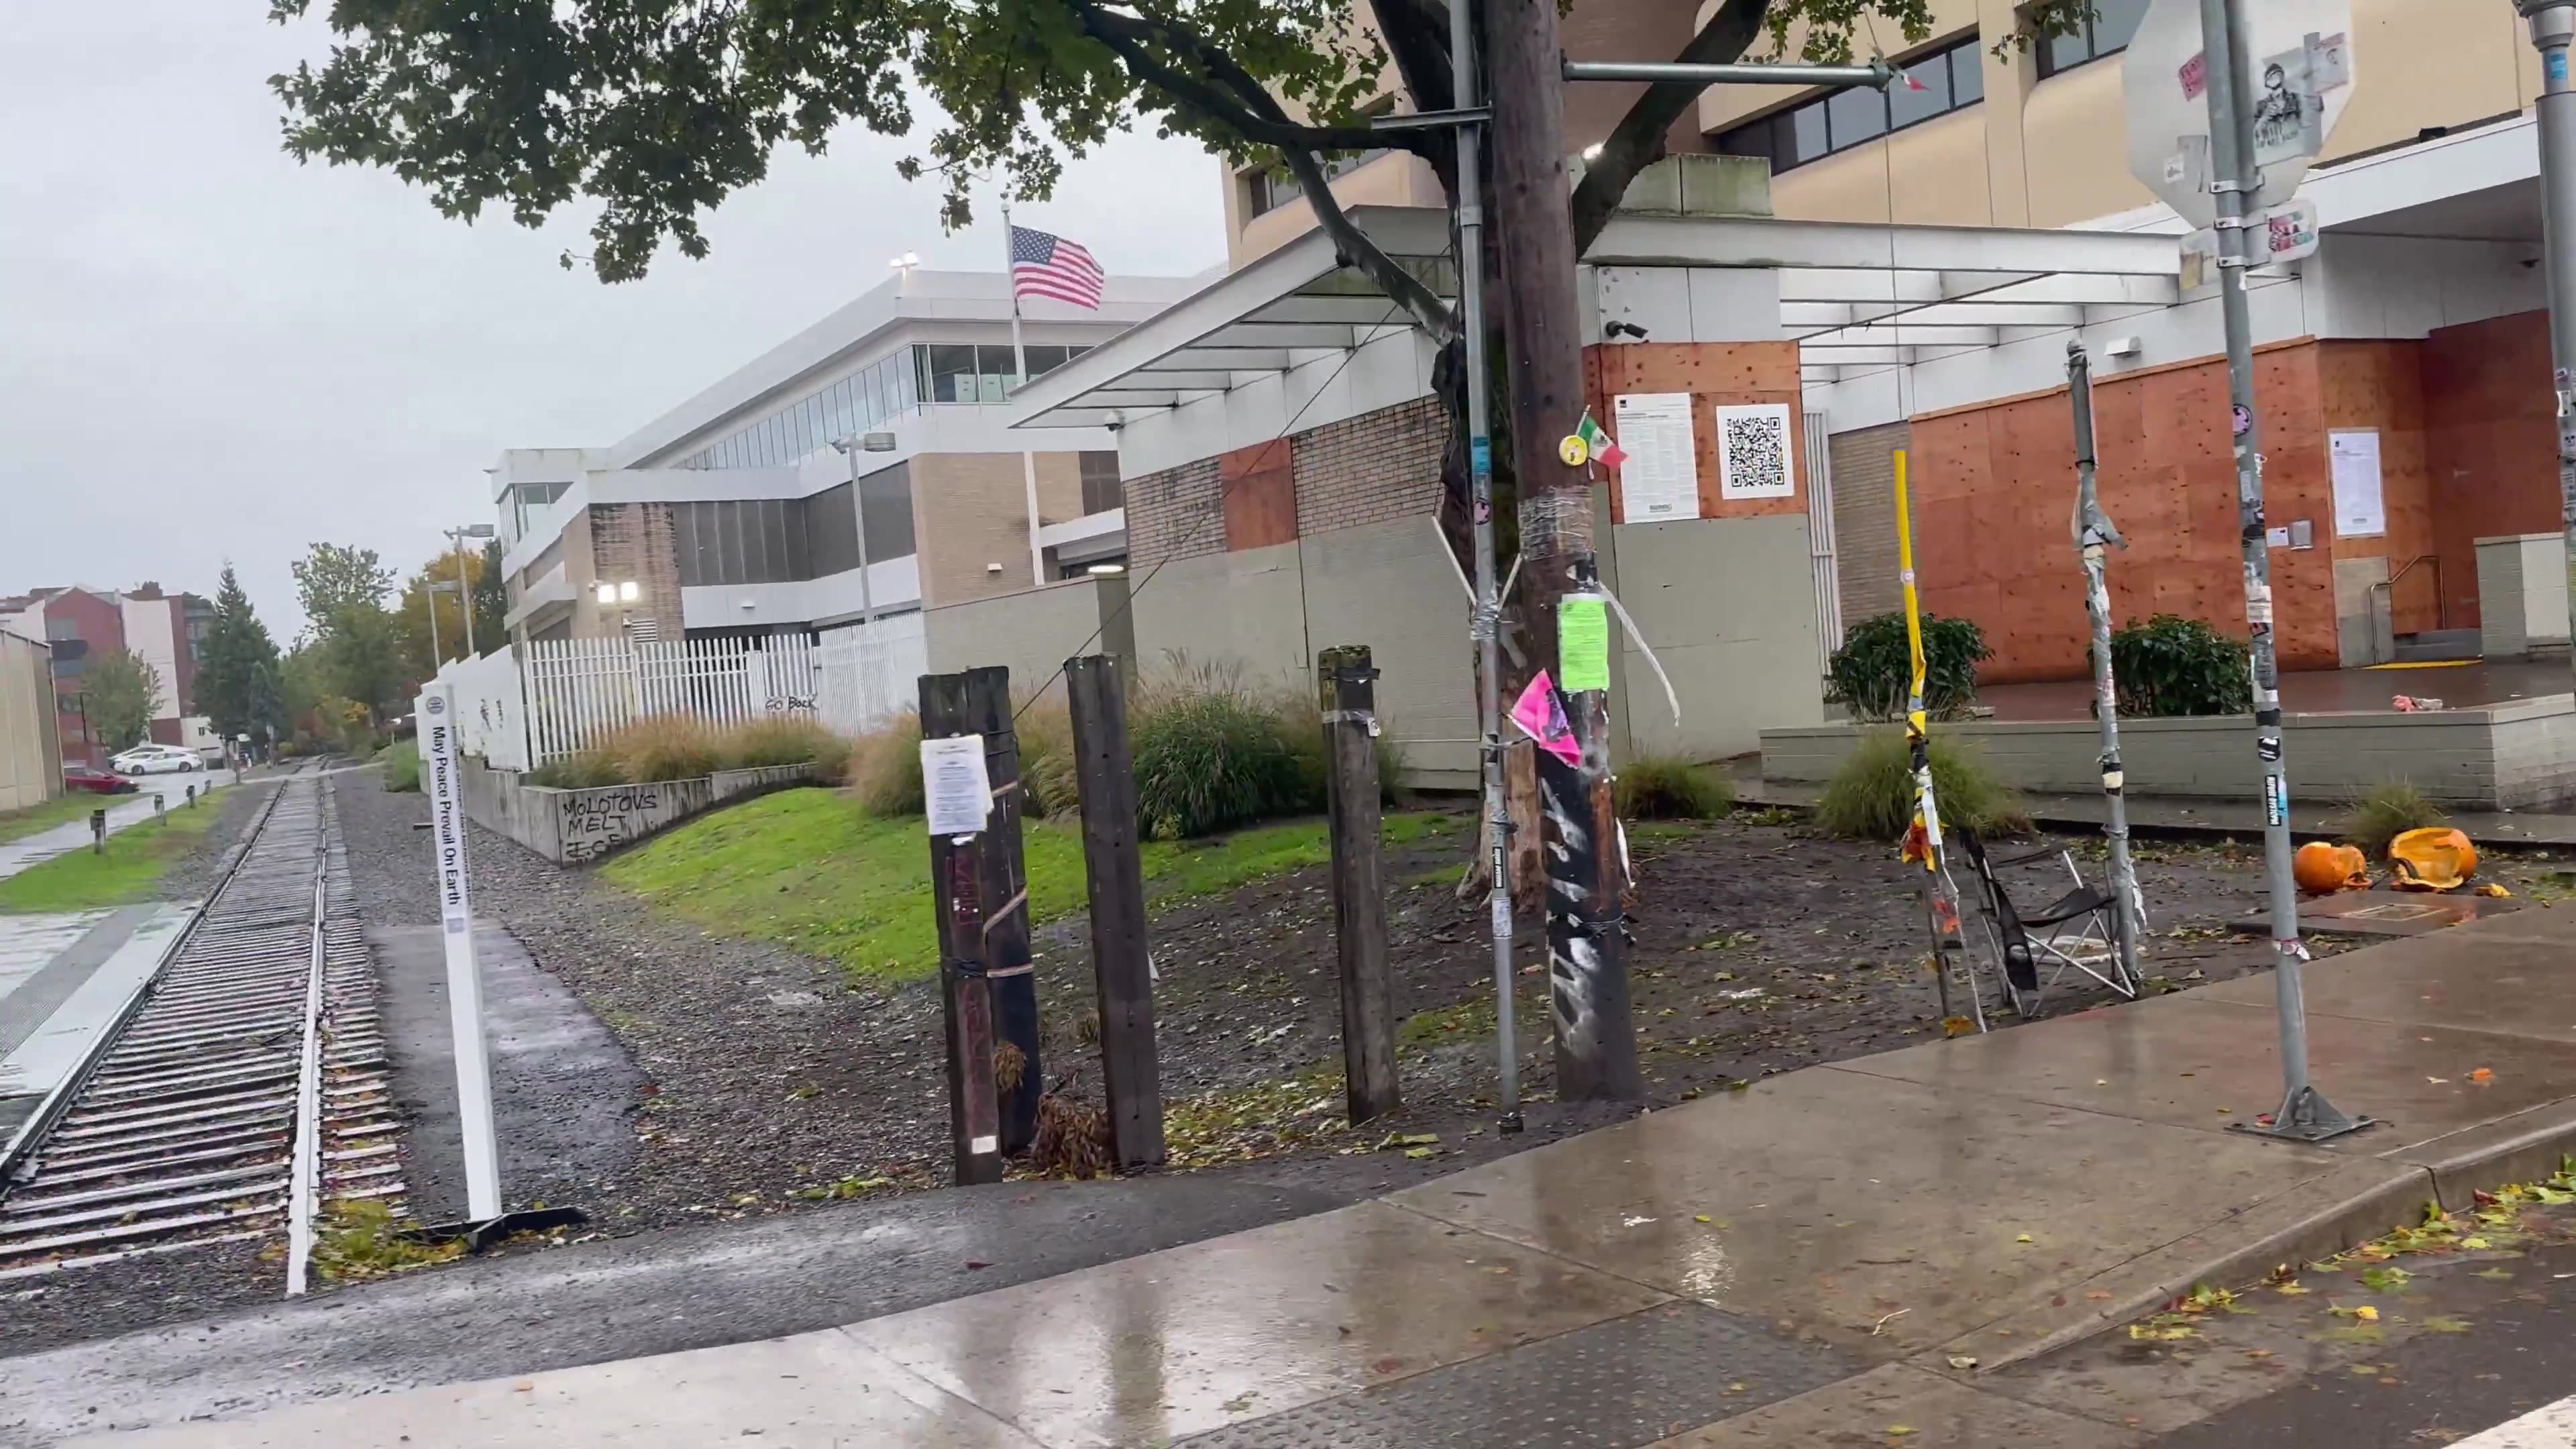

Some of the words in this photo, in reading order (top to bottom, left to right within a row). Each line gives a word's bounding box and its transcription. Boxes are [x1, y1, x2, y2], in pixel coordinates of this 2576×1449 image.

[765, 699, 783, 710] GO
[433, 727, 445, 760] May
[436, 757, 449, 798] Peace
[564, 794, 657, 816] MOLOTOVS
[440, 801, 455, 844] Prevail
[568, 815, 627, 837] MELT
[443, 846, 458, 867] On
[445, 869, 462, 905] Earth
